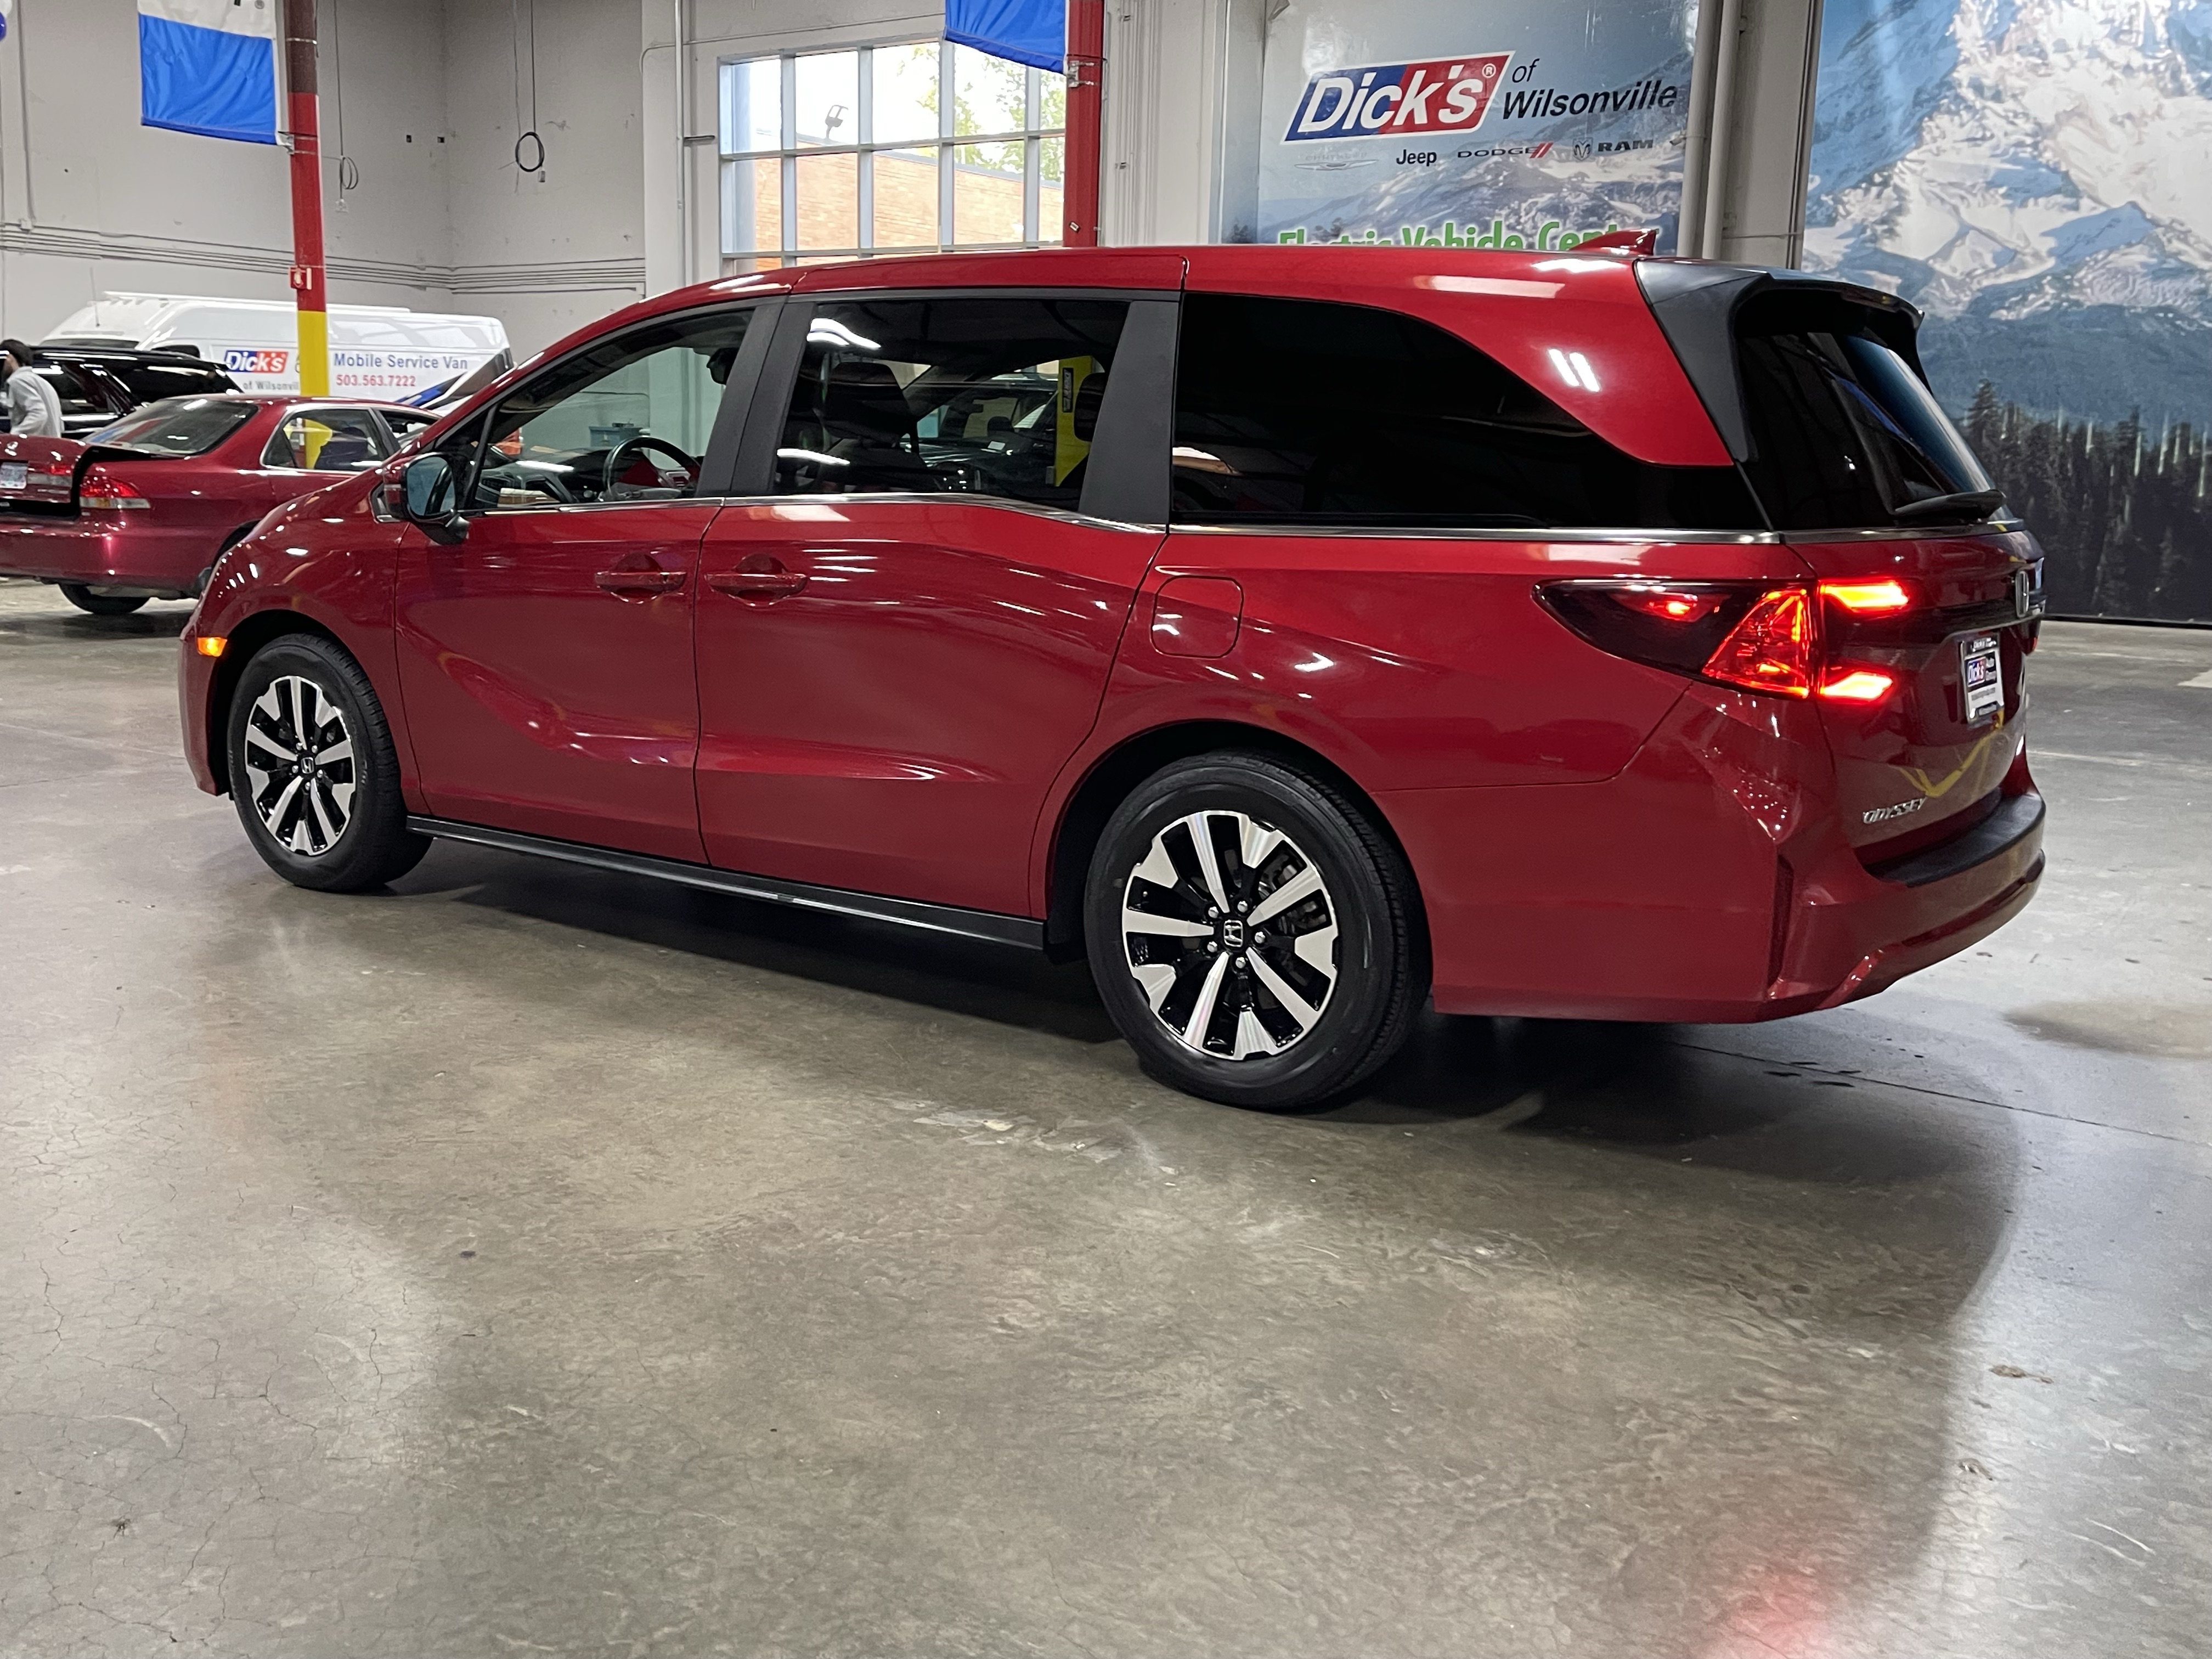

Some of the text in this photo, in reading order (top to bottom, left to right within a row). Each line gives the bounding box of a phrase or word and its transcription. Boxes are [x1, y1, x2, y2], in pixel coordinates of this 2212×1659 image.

[1512, 59, 1539, 83] of
[1503, 80, 1677, 119] Wilsonville
[1458, 146, 1538, 159] DODGE
[1598, 139, 1654, 153] RAM
[1396, 149, 1437, 166] Jeep
[334, 353, 467, 369] Mobile Service Van
[336, 374, 416, 387] 503.563.7222
[1863, 797, 1927, 824] ODYSSEY
